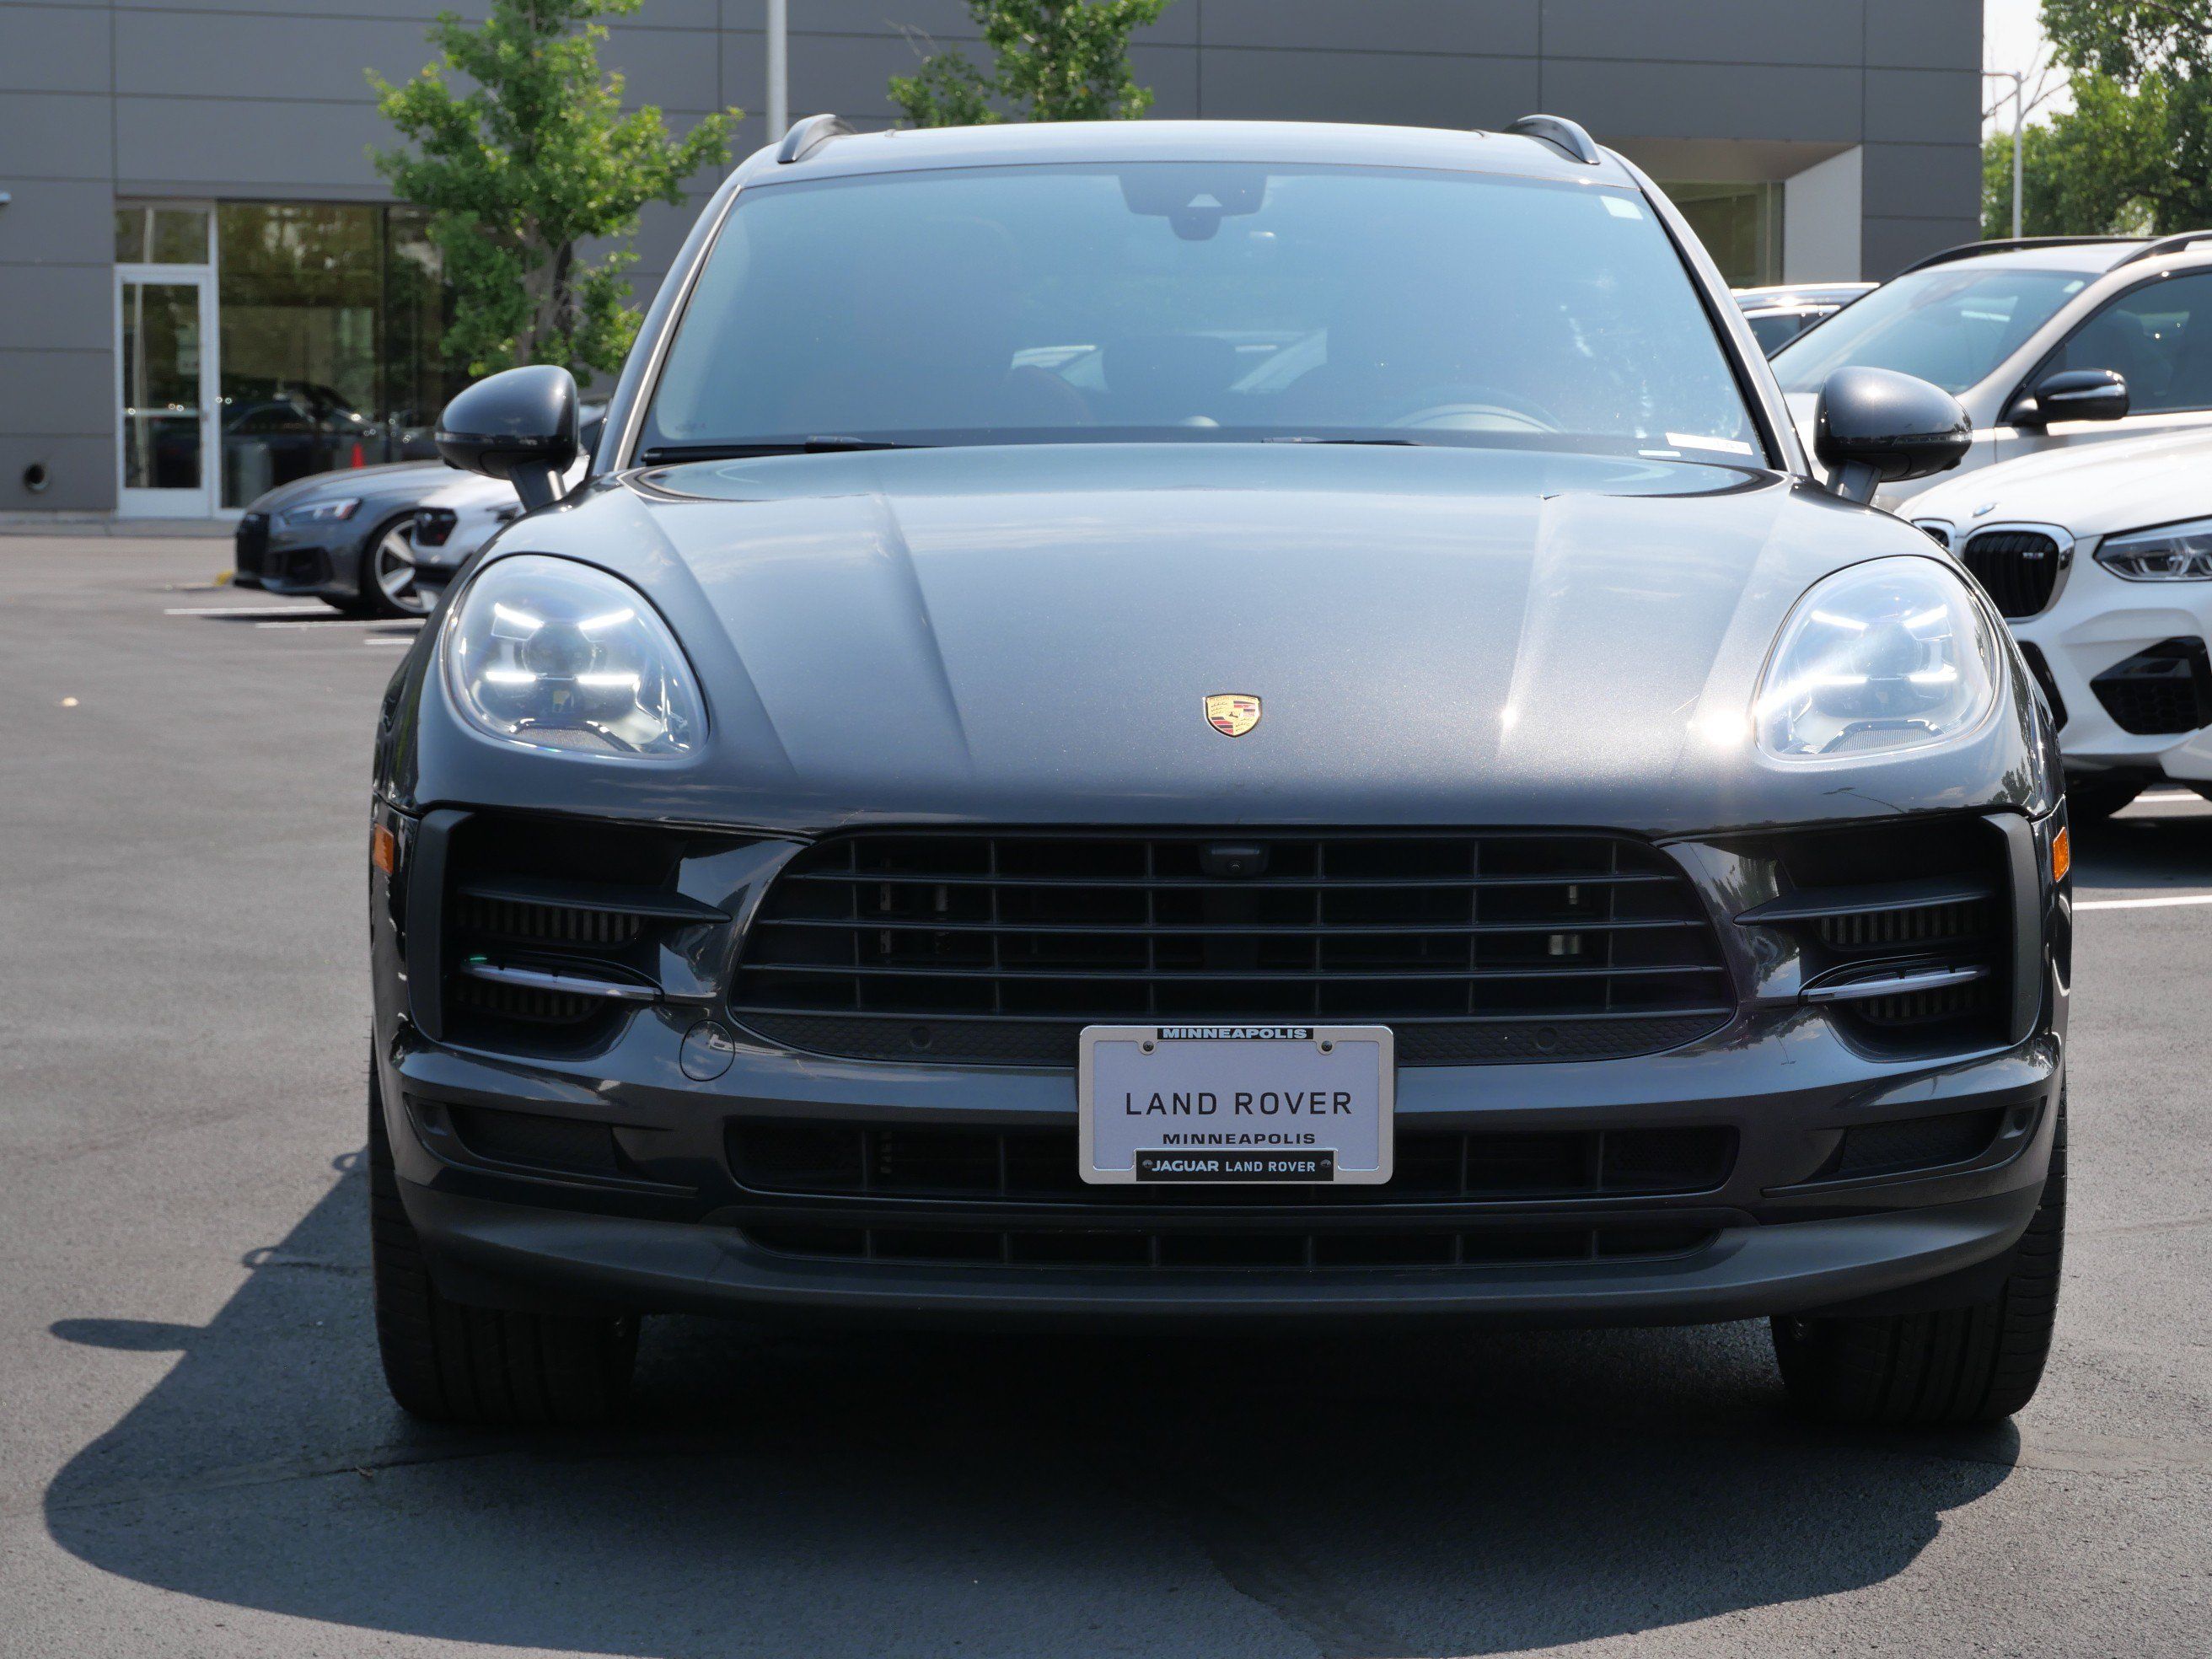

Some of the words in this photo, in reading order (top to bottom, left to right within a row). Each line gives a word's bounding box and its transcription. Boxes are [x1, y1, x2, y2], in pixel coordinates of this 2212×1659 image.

[1162, 1028, 1307, 1039] MINNEAPOLIS
[1125, 1093, 1217, 1115] LAND
[1235, 1092, 1353, 1115] ROVER
[1162, 1133, 1316, 1145] MINNEAPOLIS
[1152, 1160, 1220, 1172] JAGUAR
[1225, 1161, 1264, 1172] LAND
[1268, 1161, 1316, 1172] ROVER
